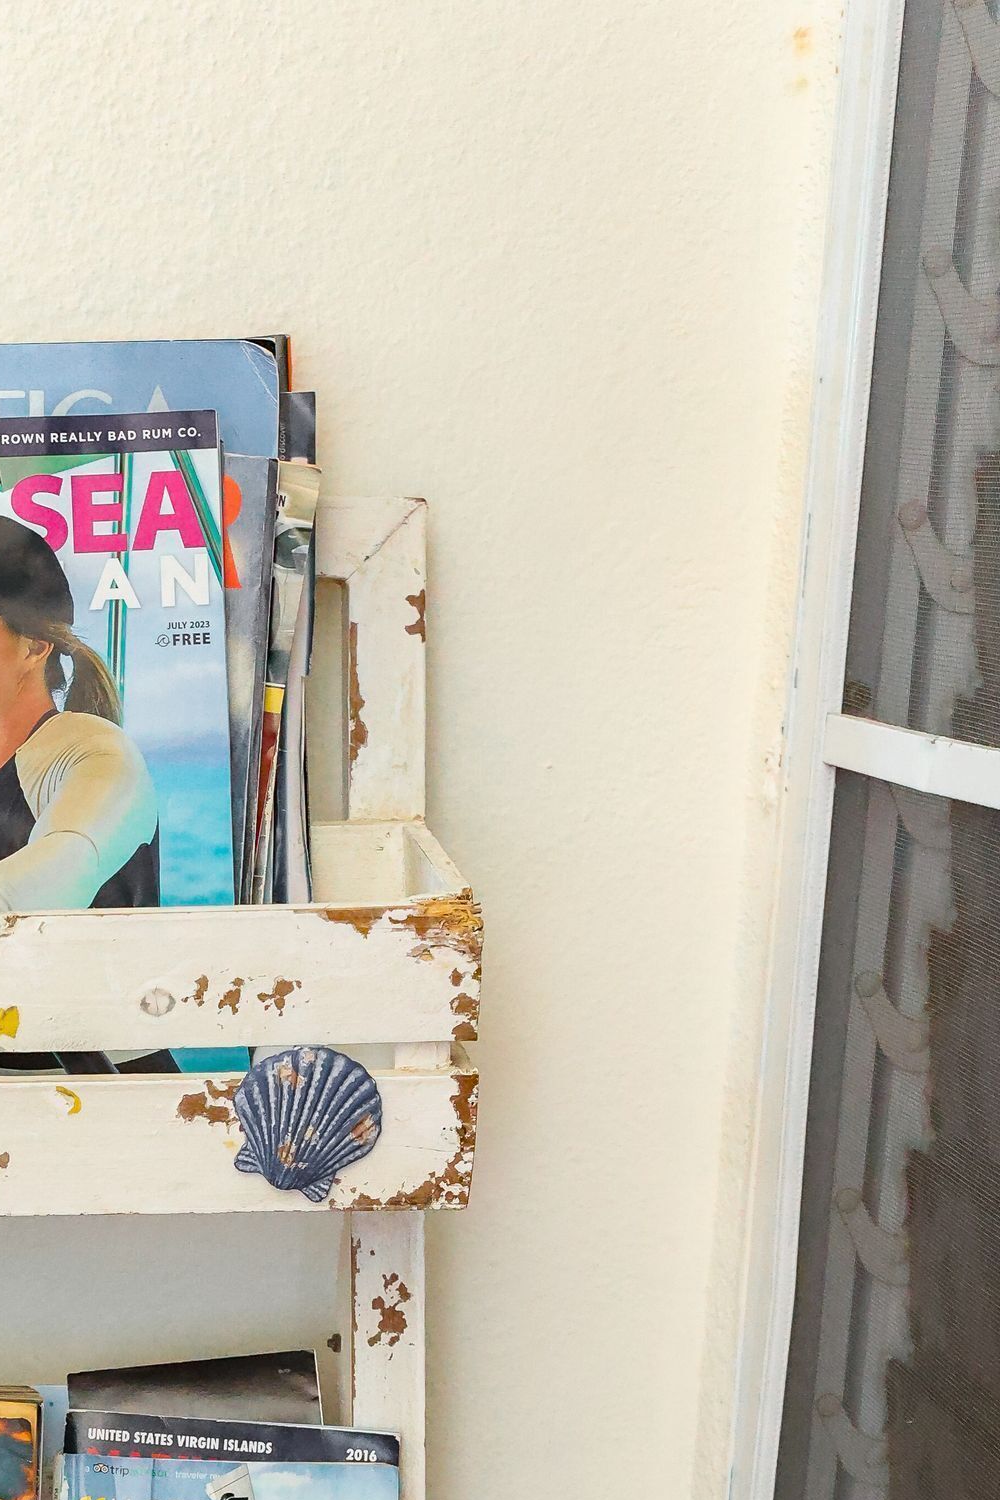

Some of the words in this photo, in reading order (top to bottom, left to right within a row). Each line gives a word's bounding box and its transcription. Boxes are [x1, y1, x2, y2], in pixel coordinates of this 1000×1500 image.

[50, 431, 102, 443] REALLY
[108, 430, 137, 441] BAD
[142, 428, 172, 440] RUM
[178, 427, 201, 438] CO.
[10, 470, 207, 554] SEA
[167, 621, 187, 630] JULY
[190, 620, 210, 629] 2023
[172, 632, 211, 646] FREE
[87, 1427, 130, 1443] UNITED
[133, 1431, 173, 1447] STATES
[177, 1434, 220, 1450] VIRGIN
[223, 1439, 273, 1455] ISLANDS
[346, 1448, 378, 1462] 2016
